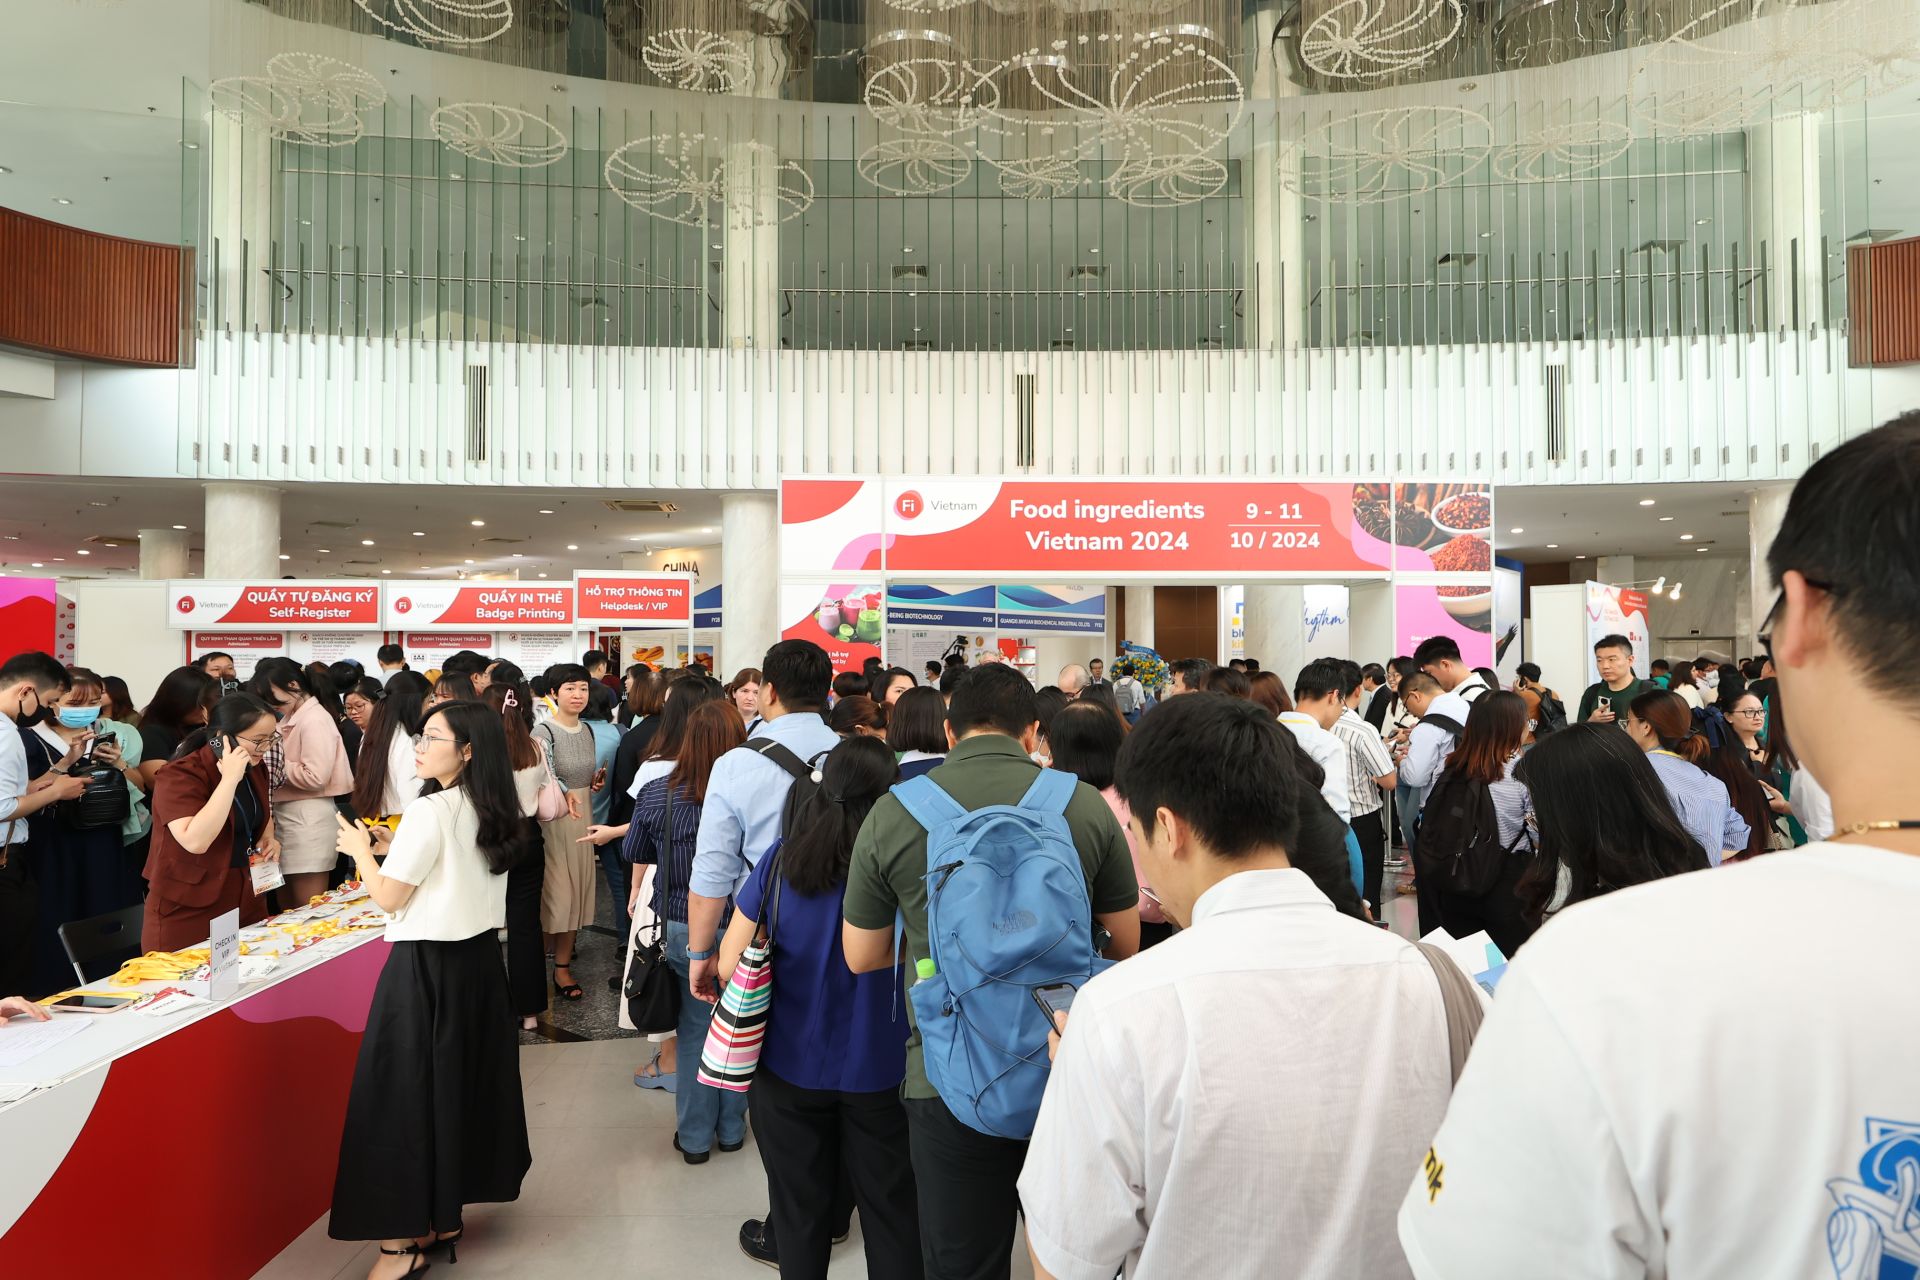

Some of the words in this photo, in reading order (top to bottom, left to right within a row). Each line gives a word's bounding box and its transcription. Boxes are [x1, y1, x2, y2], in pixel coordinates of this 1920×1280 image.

[902, 500, 915, 512] Fi
[931, 500, 978, 511] Vietnam
[1010, 499, 1067, 519] Food
[1075, 499, 1205, 523] ingredients
[1246, 503, 1259, 519] 9
[1280, 503, 1303, 519] 11
[1025, 531, 1123, 550] Vietnam
[1131, 531, 1189, 550] 2024
[1230, 532, 1254, 548] 10
[1271, 532, 1320, 548] 2024
[289, 589, 310, 604] TỰ
[311, 588, 352, 603] ĐĂNG
[355, 587, 373, 602] KÝ
[520, 592, 535, 603] IN
[537, 589, 563, 604] THẺ
[585, 584, 601, 596] HỖ
[604, 586, 625, 598] TRỢ
[628, 586, 664, 597] THÔNG
[666, 588, 683, 597] TIN
[200, 601, 229, 609] Vietnam
[416, 602, 444, 610] Vietnam
[600, 601, 644, 612] Helpdesk
[652, 602, 668, 611] VIP
[269, 606, 352, 619] Self-Register
[476, 607, 514, 620] Badge
[517, 607, 566, 620] Printing
[904, 613, 944, 621] BIOTECHNOLOGY
[1303, 606, 1345, 643] hythm
[214, 936, 231, 950] CHECK
[221, 948, 230, 960] VIP
